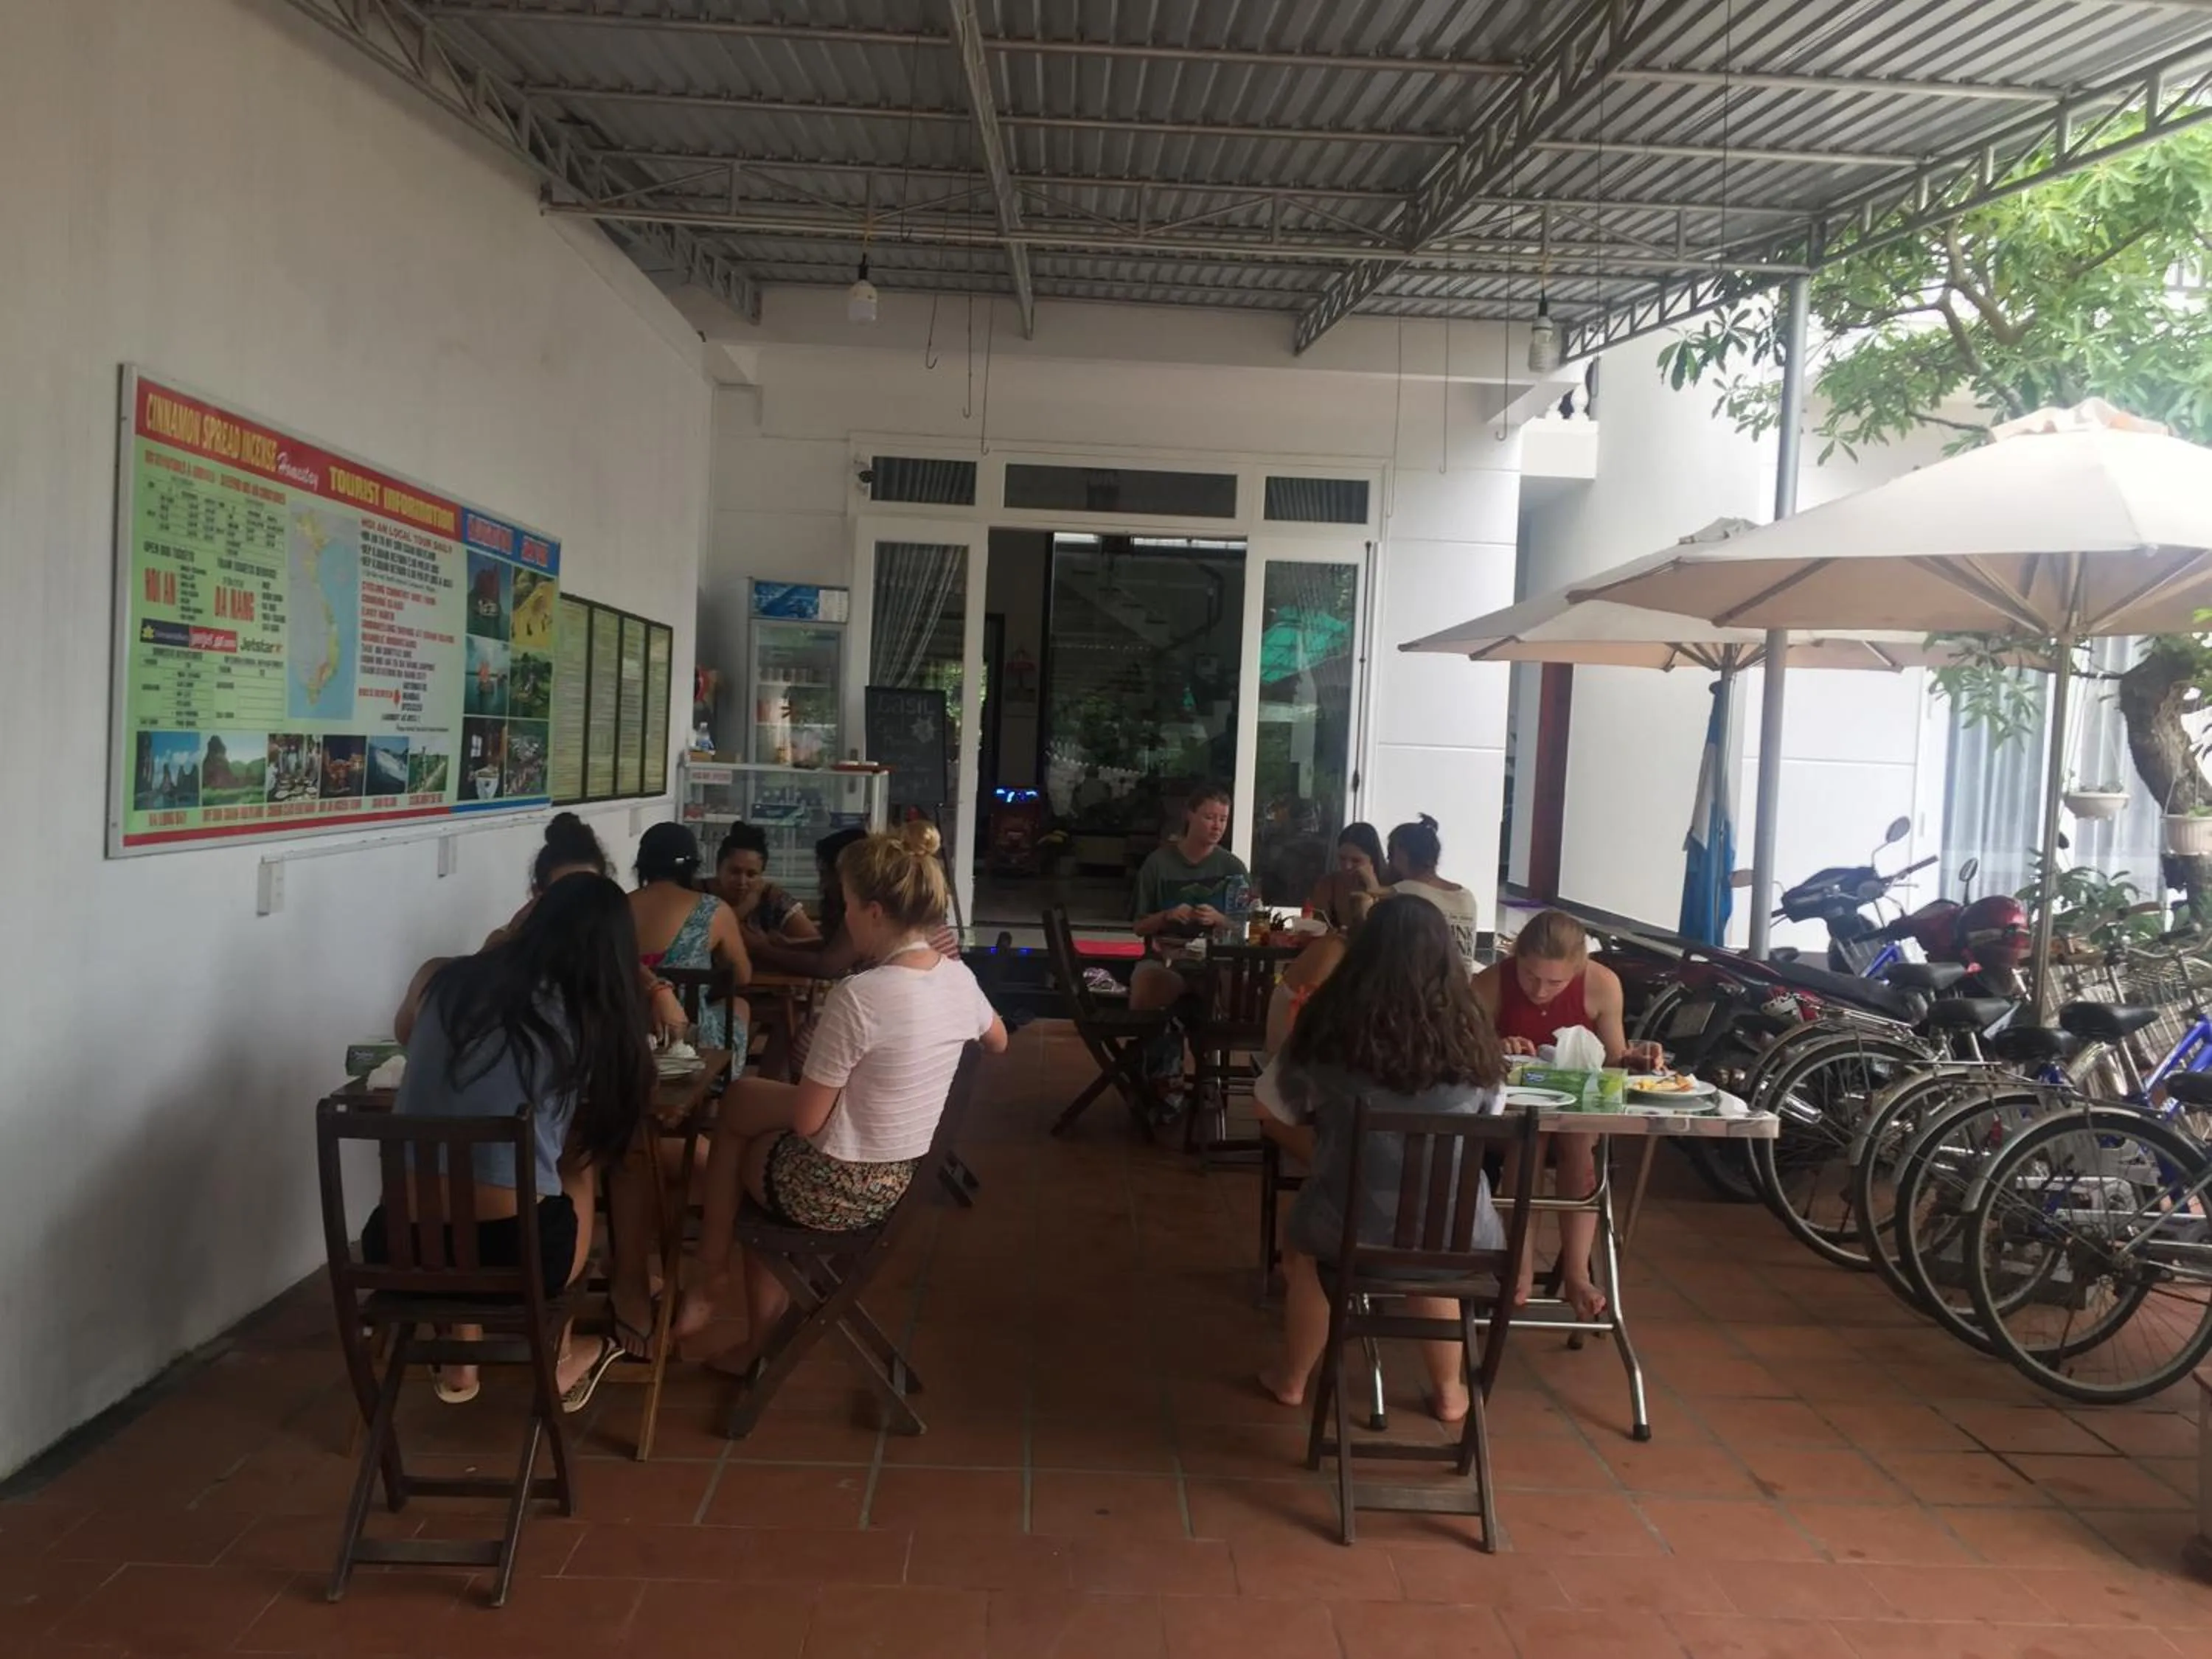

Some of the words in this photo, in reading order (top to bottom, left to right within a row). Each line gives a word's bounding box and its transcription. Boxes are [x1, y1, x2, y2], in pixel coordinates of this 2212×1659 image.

[202, 413, 241, 459] SPREAD
[330, 466, 380, 507] TOURIST
[383, 484, 456, 533] INFORMATION
[230, 589, 255, 622] NANG
